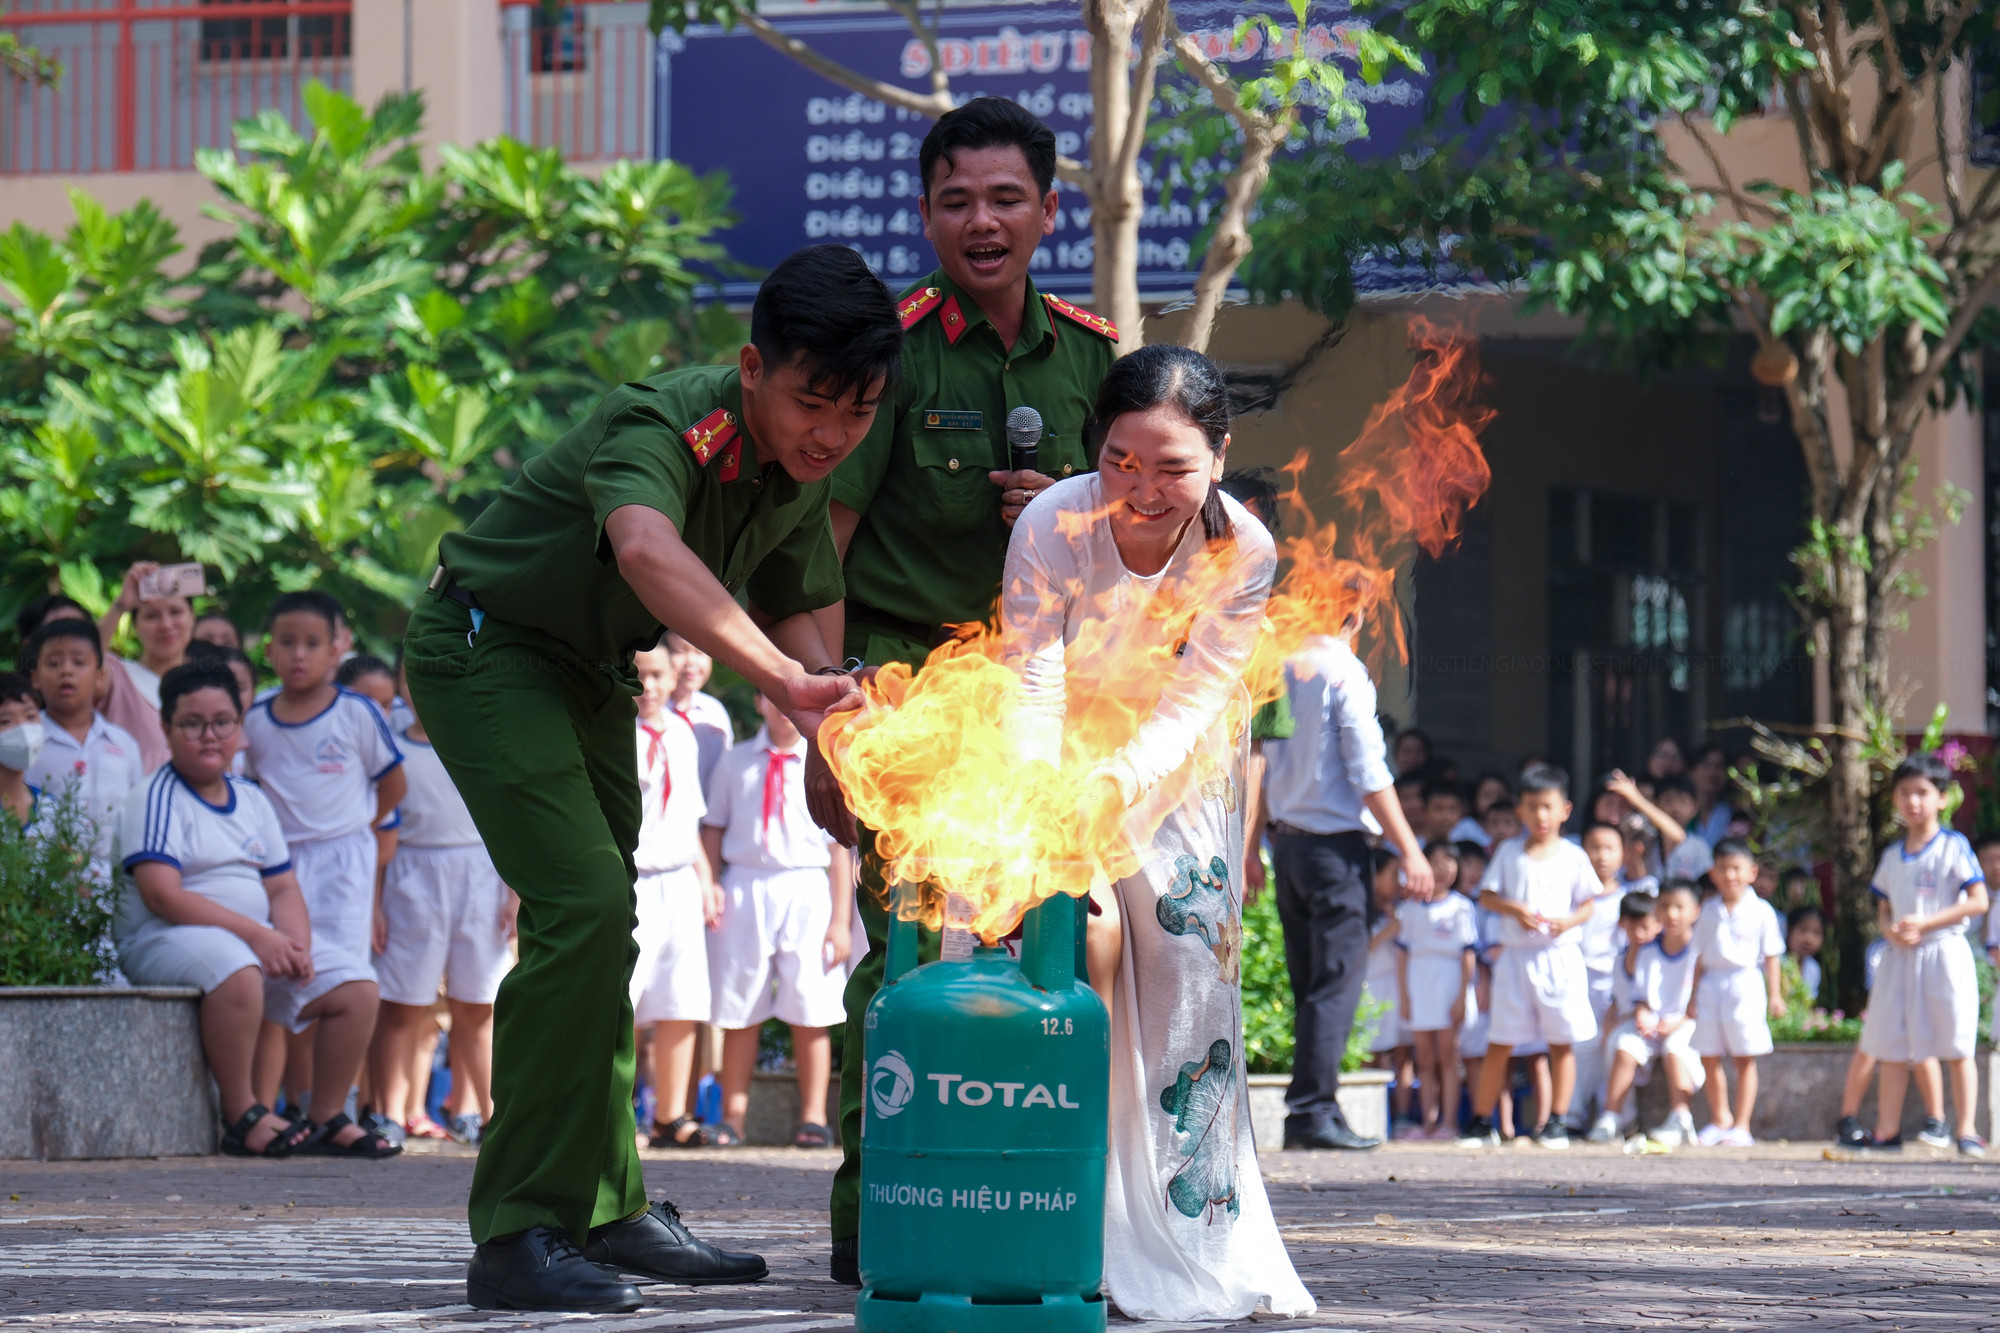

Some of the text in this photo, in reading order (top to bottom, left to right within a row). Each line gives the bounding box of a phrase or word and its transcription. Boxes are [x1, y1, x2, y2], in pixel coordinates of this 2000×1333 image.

[888, 131, 922, 160] 2:
[888, 169, 921, 198] 3:
[887, 207, 921, 235] 4:
[1040, 1018, 1074, 1036] 12.6
[927, 1073, 1080, 1109] TOTAL
[869, 1183, 1077, 1213] THƯƠNG HIỆU PHÁP
